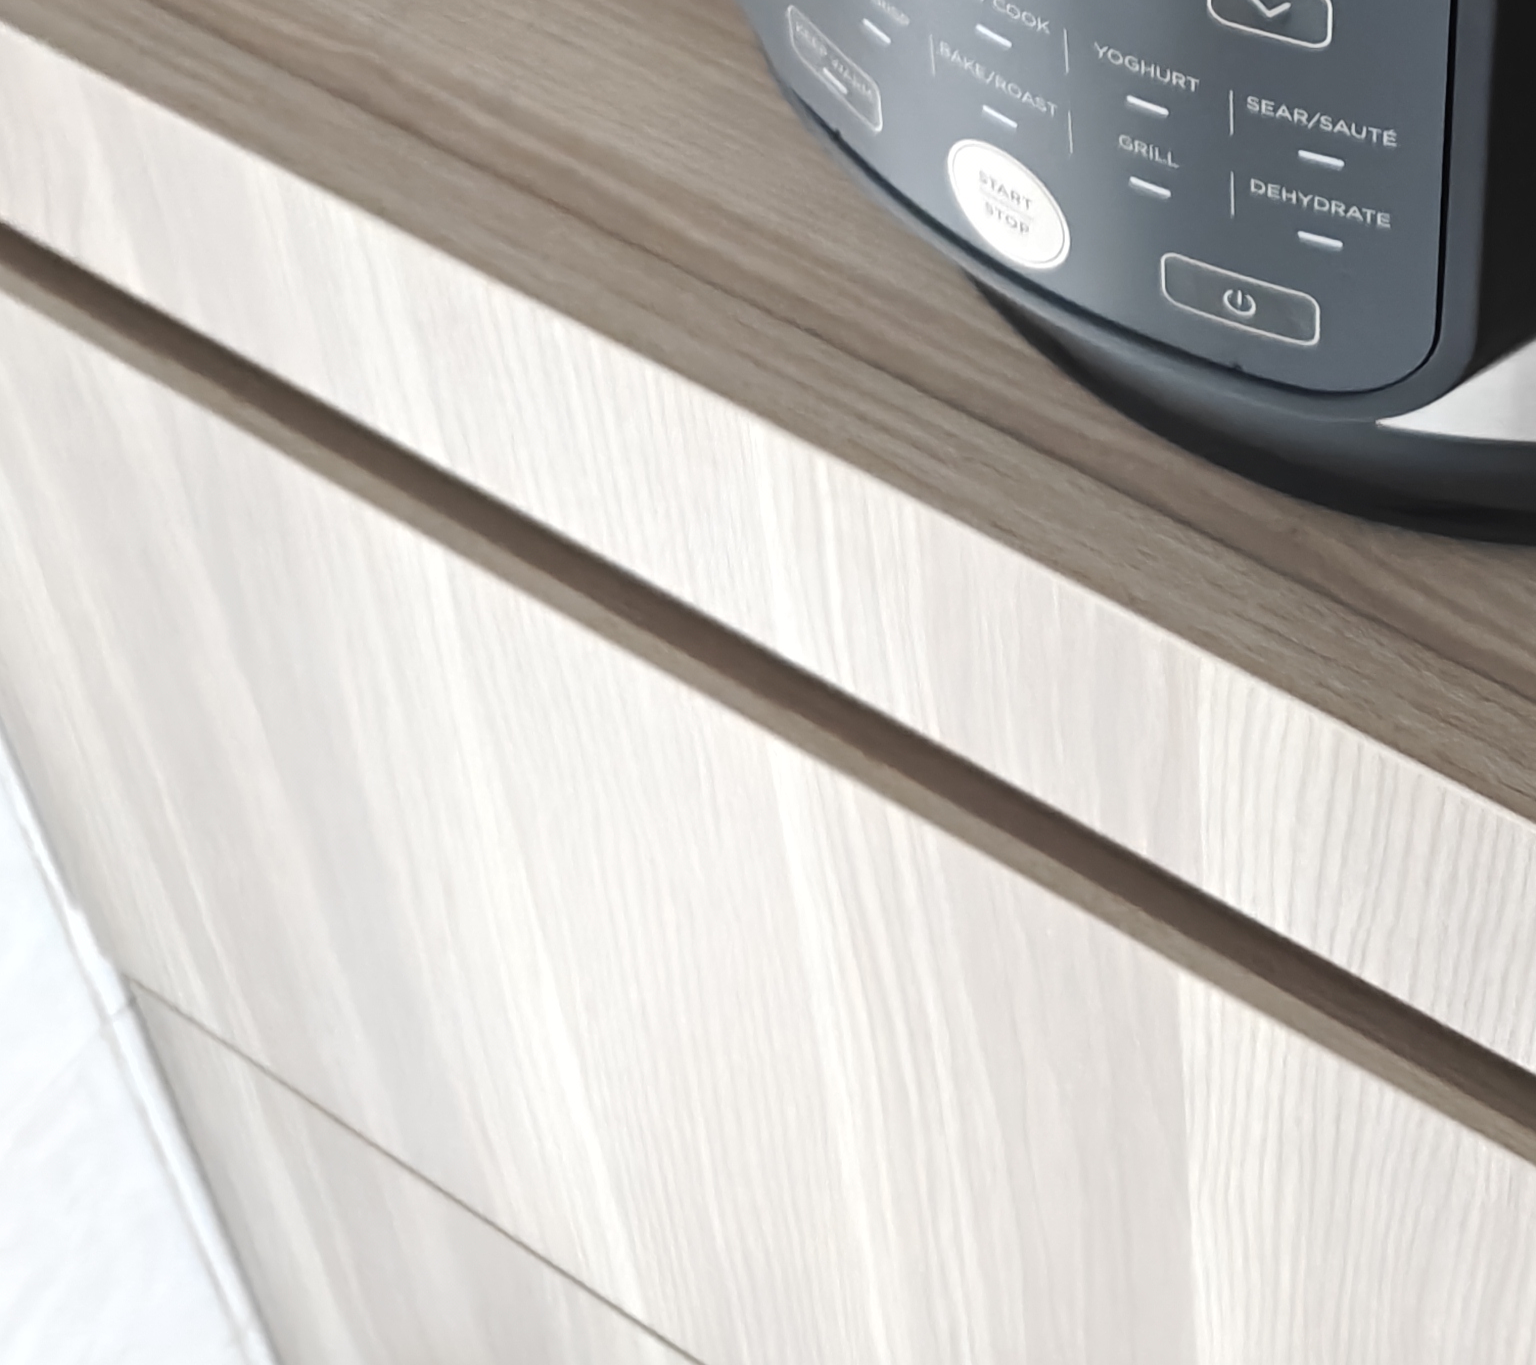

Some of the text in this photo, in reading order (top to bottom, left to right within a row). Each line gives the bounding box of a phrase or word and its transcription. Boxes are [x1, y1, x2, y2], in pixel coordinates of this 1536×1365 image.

[939, 40, 1058, 117] BAKE/ROAST
[1094, 41, 1200, 92] YOGHURT
[1246, 95, 1398, 148] SEAR/SAUTÉ
[1118, 134, 1179, 169] GRILL
[978, 169, 1033, 211] START
[1249, 177, 1391, 229] DEHYDRATE
[984, 201, 1031, 236] STOP
